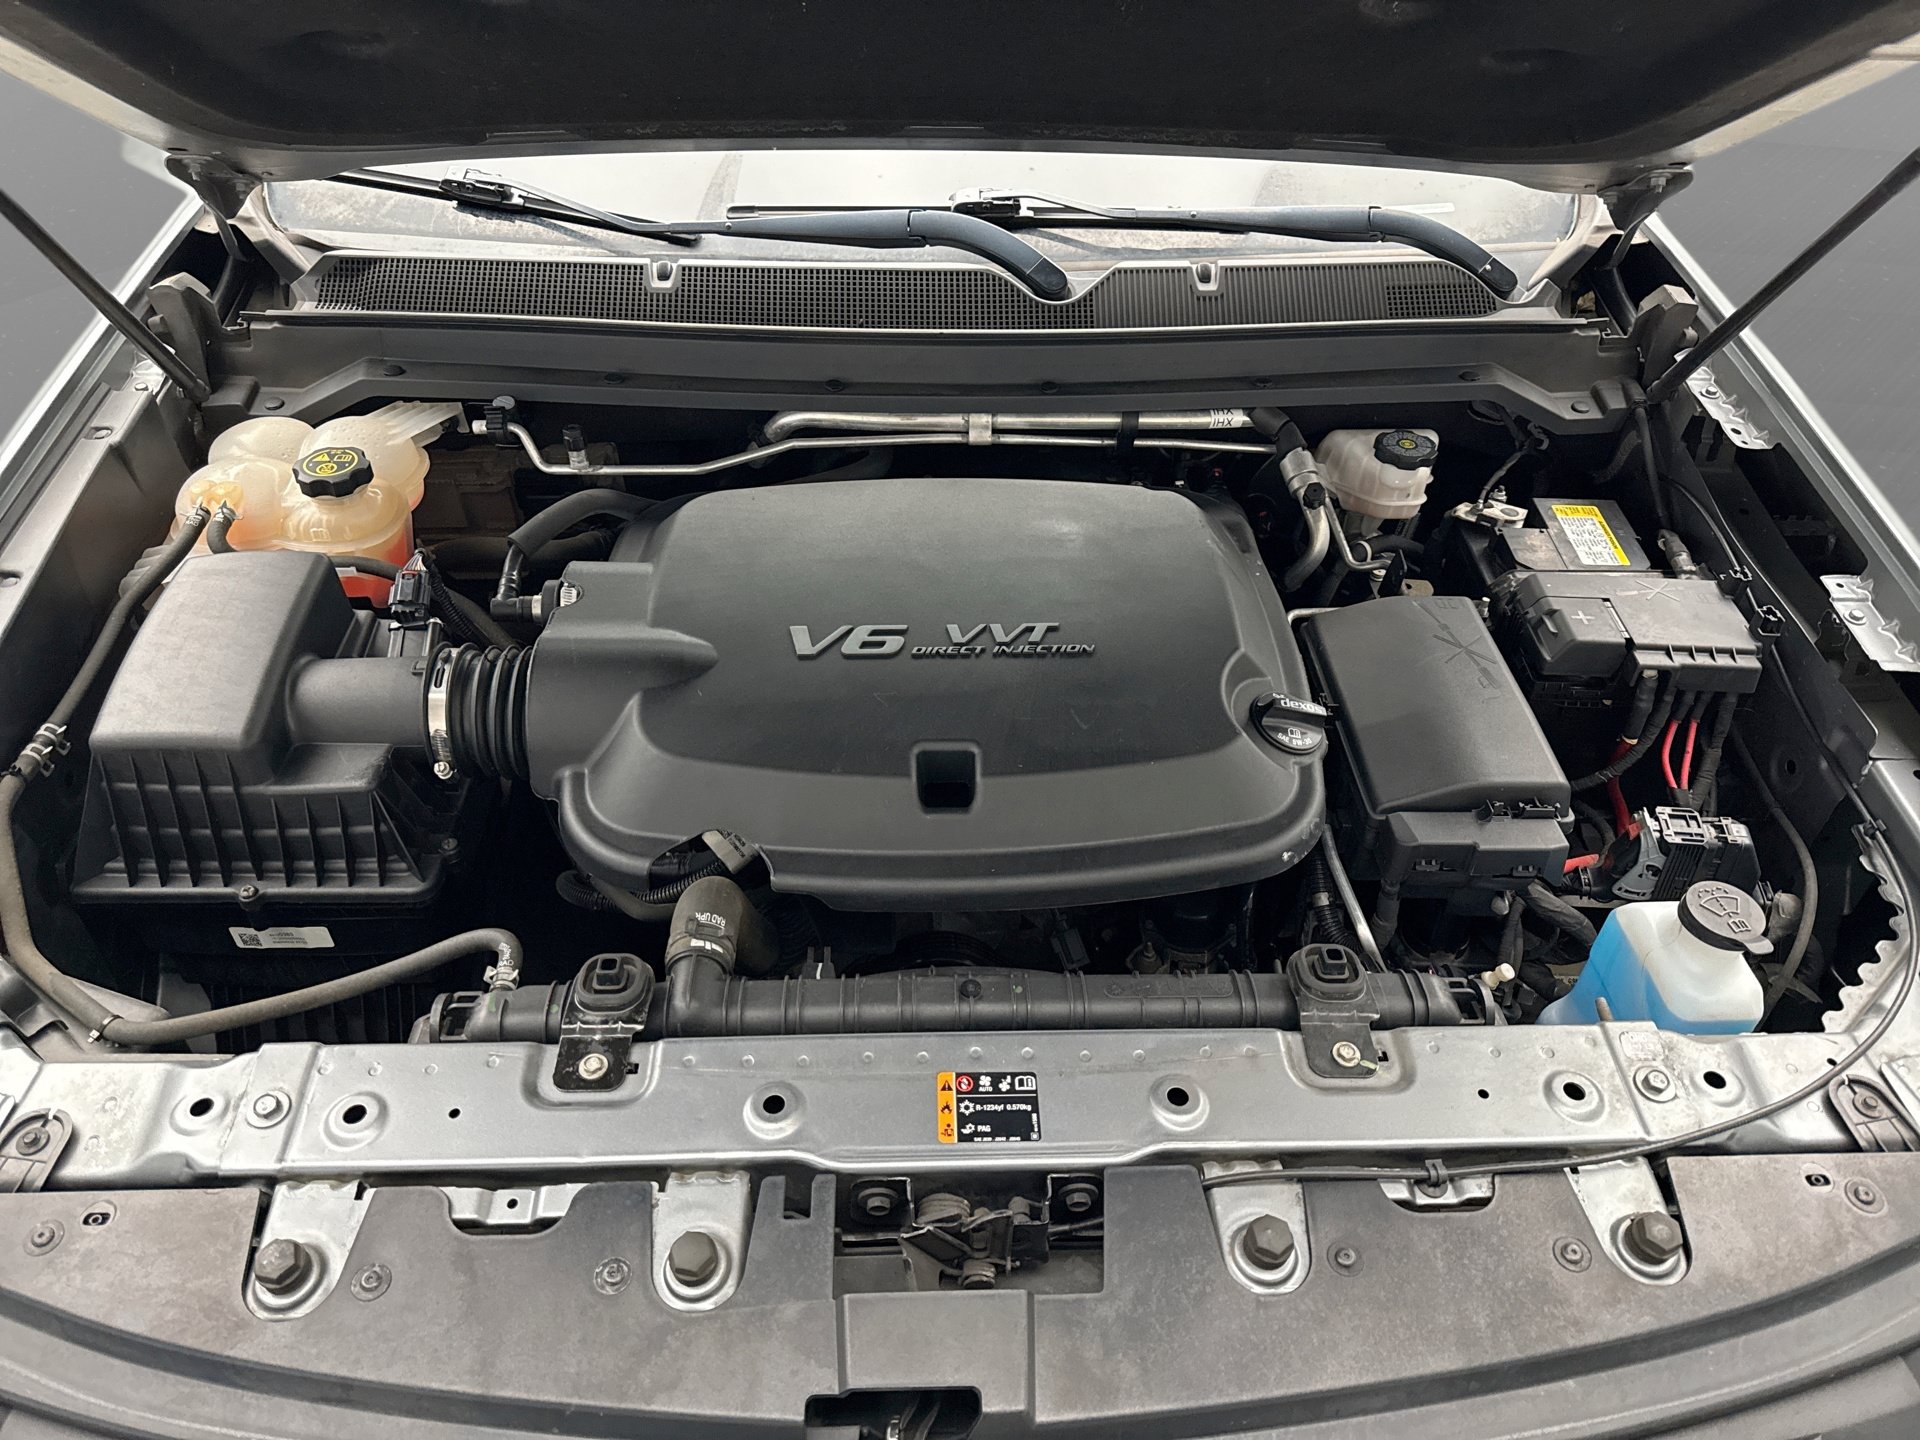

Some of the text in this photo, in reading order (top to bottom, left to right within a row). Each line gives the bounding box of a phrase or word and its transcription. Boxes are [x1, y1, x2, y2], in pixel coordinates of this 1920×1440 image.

[1213, 417, 1233, 427] IHX
[946, 622, 1060, 644] VVT
[790, 624, 908, 658] V6
[911, 643, 1096, 658] DIRECT INJECTION
[711, 914, 726, 927] RAD
